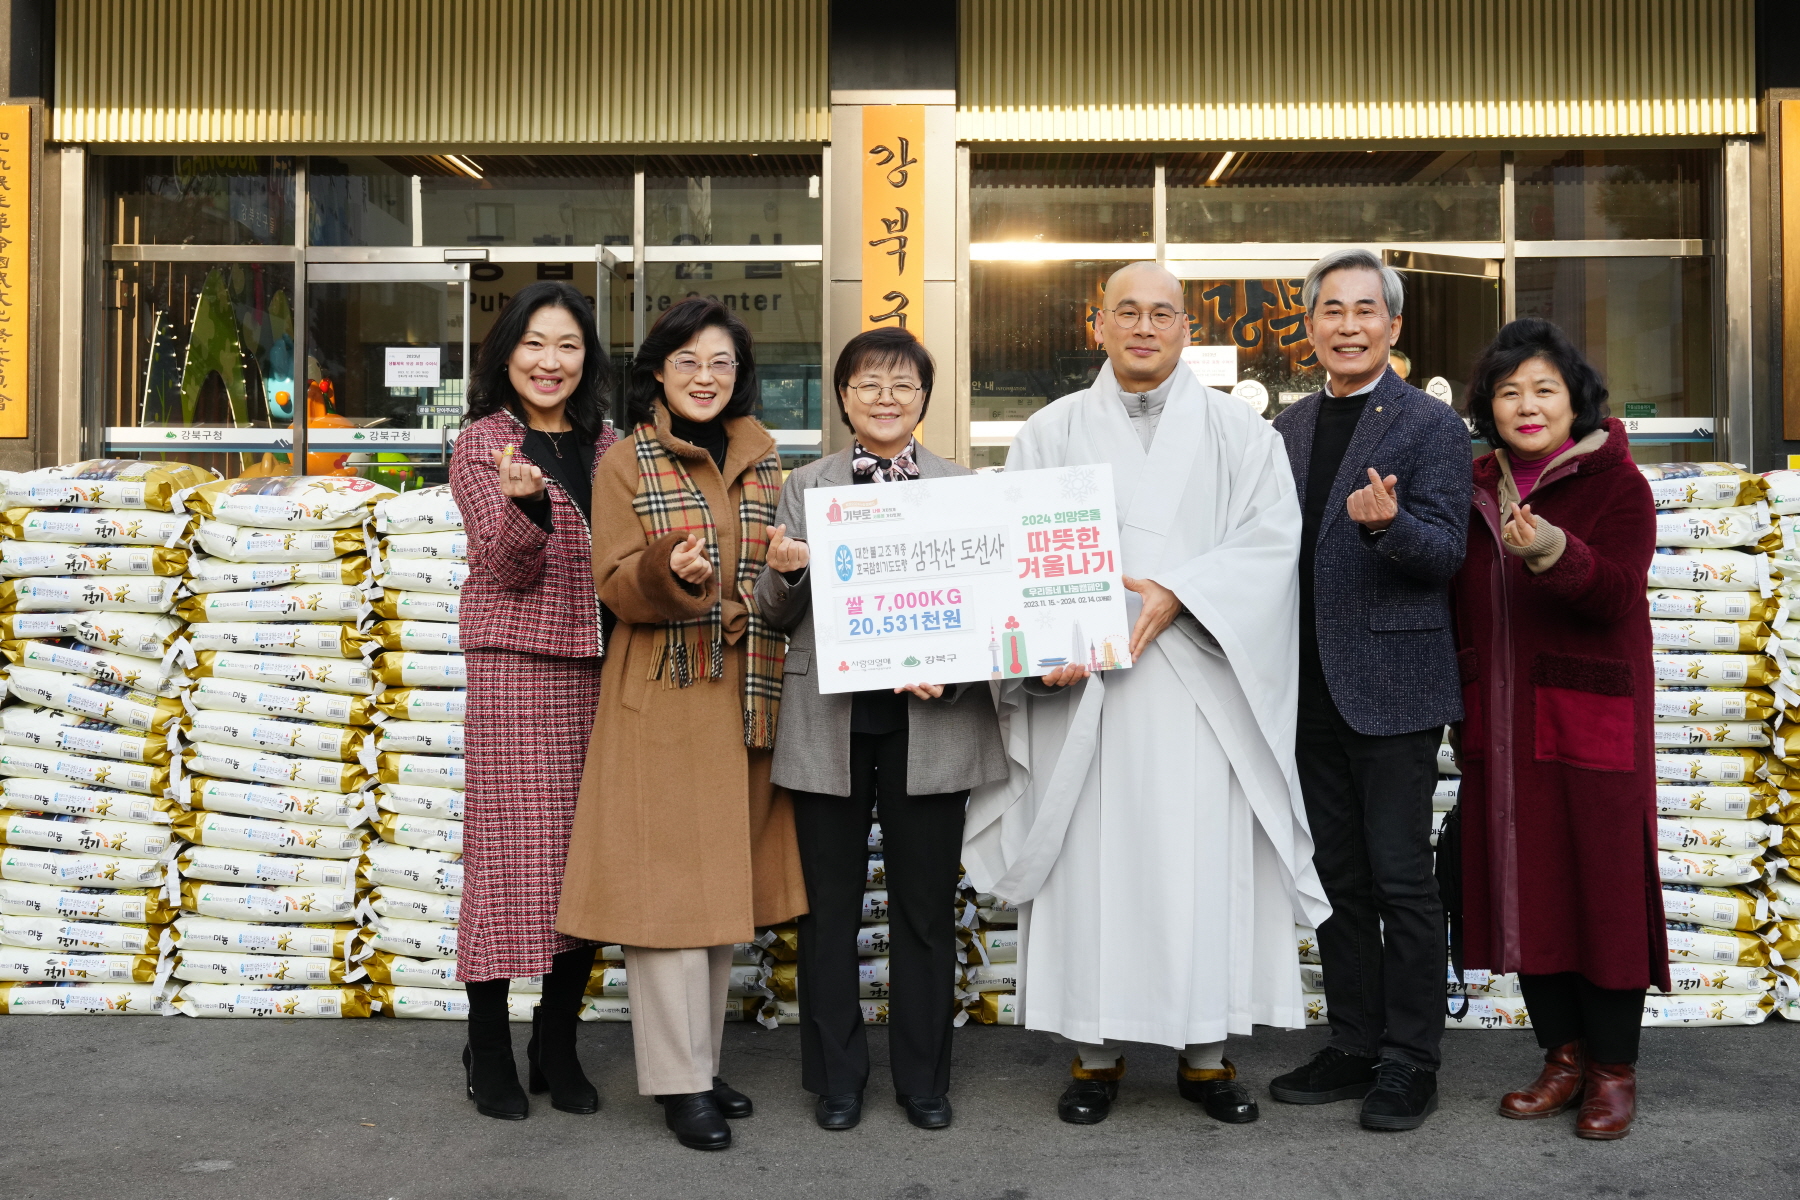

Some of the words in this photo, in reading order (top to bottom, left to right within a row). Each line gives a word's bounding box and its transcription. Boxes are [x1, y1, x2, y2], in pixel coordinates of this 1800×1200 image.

[180, 430, 223, 441] 강북구청
[369, 430, 411, 442] 강북구청
[844, 509, 871, 521] 기부로
[1022, 514, 1051, 526] 2024
[1054, 509, 1101, 523] 희망온돌
[94, 526, 117, 538] 경기
[1027, 526, 1100, 552] 따뜻한
[911, 538, 956, 571] 삼각산
[960, 533, 1005, 566] 도선사
[64, 560, 88, 572] 경기
[1018, 550, 1114, 579] 겨울나기
[1029, 585, 1062, 596] 우리동네
[82, 592, 104, 604] 경기
[846, 596, 864, 615] 쌀
[874, 588, 962, 612] 7,000KG
[849, 608, 961, 636] 20,531천원
[78, 630, 99, 642] 경기
[851, 658, 891, 668] 사랑의열매
[924, 654, 957, 664] 강북구
[94, 668, 115, 680] 경기
[78, 838, 99, 849] 경기
[57, 936, 78, 947] 경기
[44, 968, 66, 978] 경기
[1677, 979, 1700, 990] 경기
[1479, 1016, 1502, 1028] 경기
